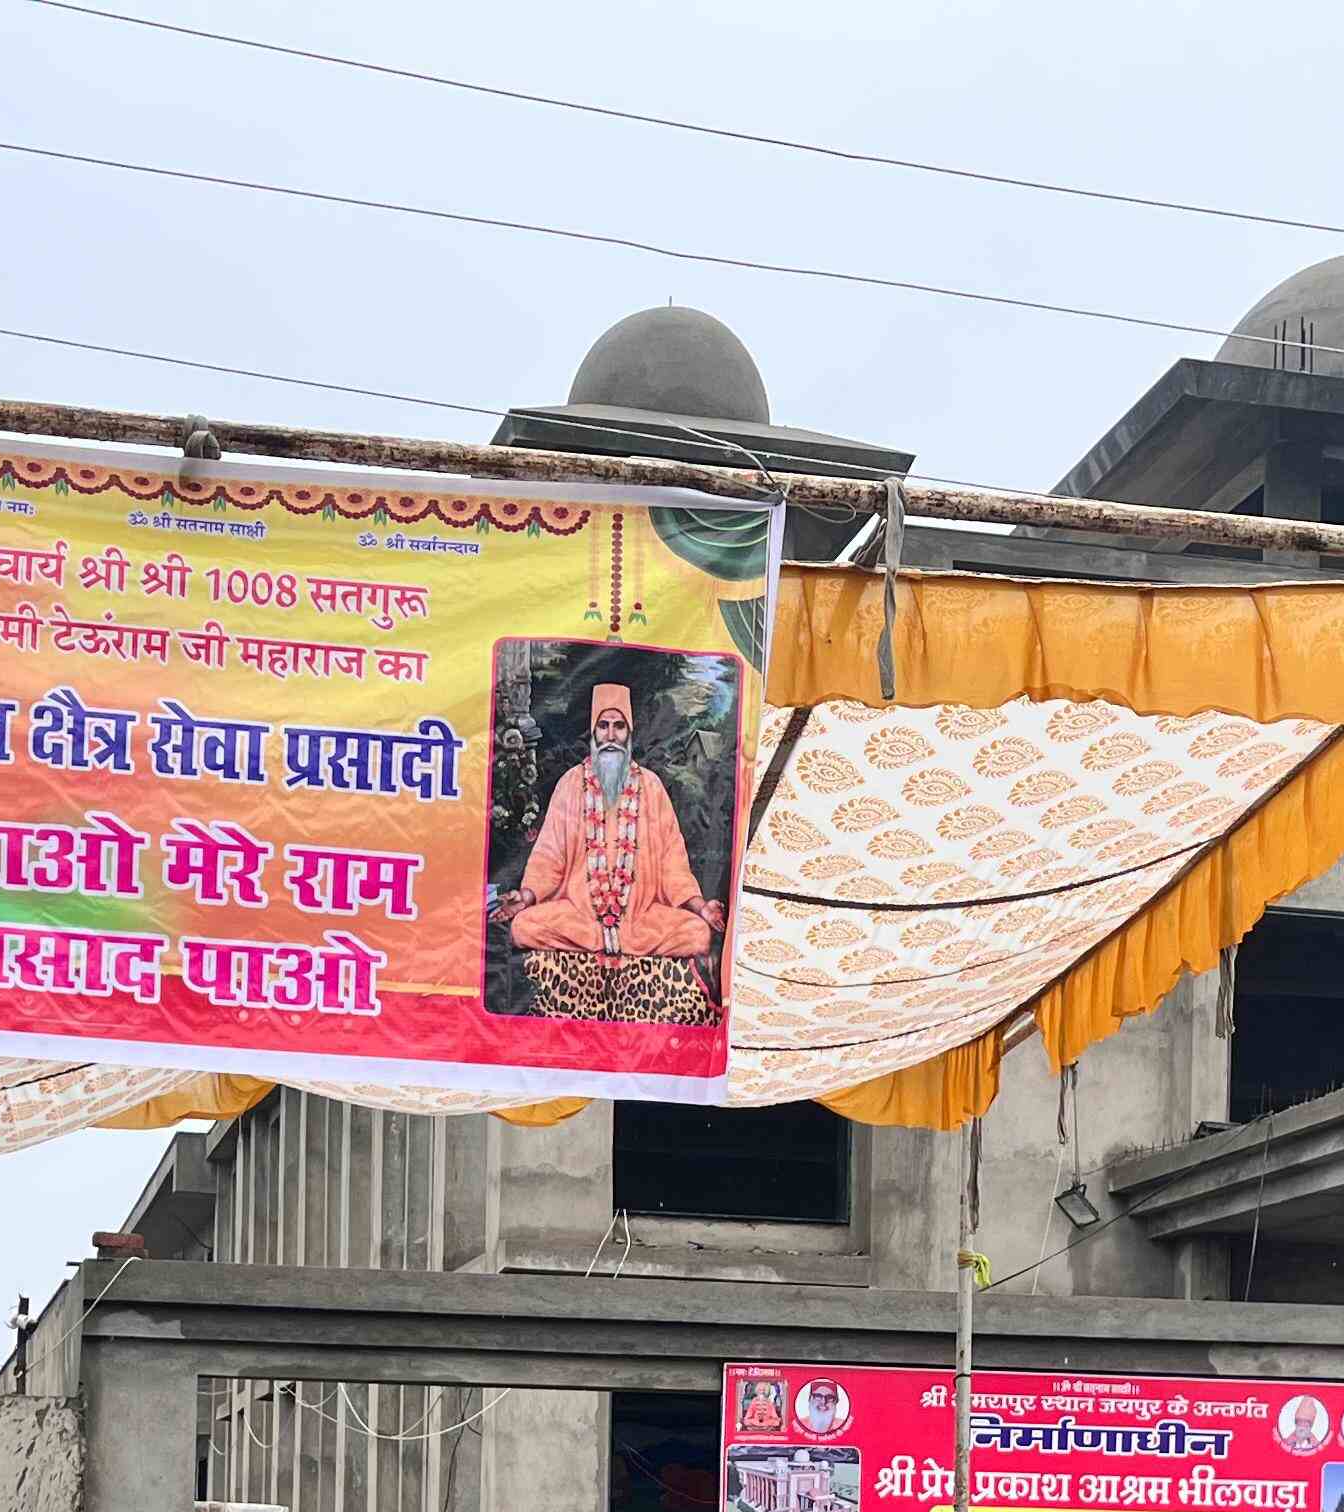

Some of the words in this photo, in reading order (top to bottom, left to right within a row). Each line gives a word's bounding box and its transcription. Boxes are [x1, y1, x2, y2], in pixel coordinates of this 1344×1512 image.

[128, 511, 149, 528] ॐ
[152, 514, 172, 532] श्री
[176, 520, 225, 536] सतनाम
[358, 532, 379, 548] ॐ
[385, 532, 405, 551] श्री
[80, 545, 131, 593] श्री
[141, 549, 191, 602] श्री
[207, 565, 296, 610] 1008
[179, 620, 232, 670] जी
[239, 634, 364, 680] महाराज
[377, 646, 425, 683] का
[151, 700, 270, 780] सेवा
[283, 720, 461, 802] प्रसादी
[164, 822, 273, 906] मेरे
[290, 845, 420, 919] राम
[181, 931, 382, 1015] पाओ
[921, 1386, 946, 1409] श्री
[952, 1394, 1035, 1419] मरापुर
[1040, 1395, 1095, 1413] स्थान
[1099, 1398, 1161, 1419] जयपुर
[1167, 1396, 1188, 1415] के
[875, 1456, 914, 1498] श्री
[972, 1471, 1069, 1503] प्रकाश
[1086, 1474, 1172, 1505] आश्रम
